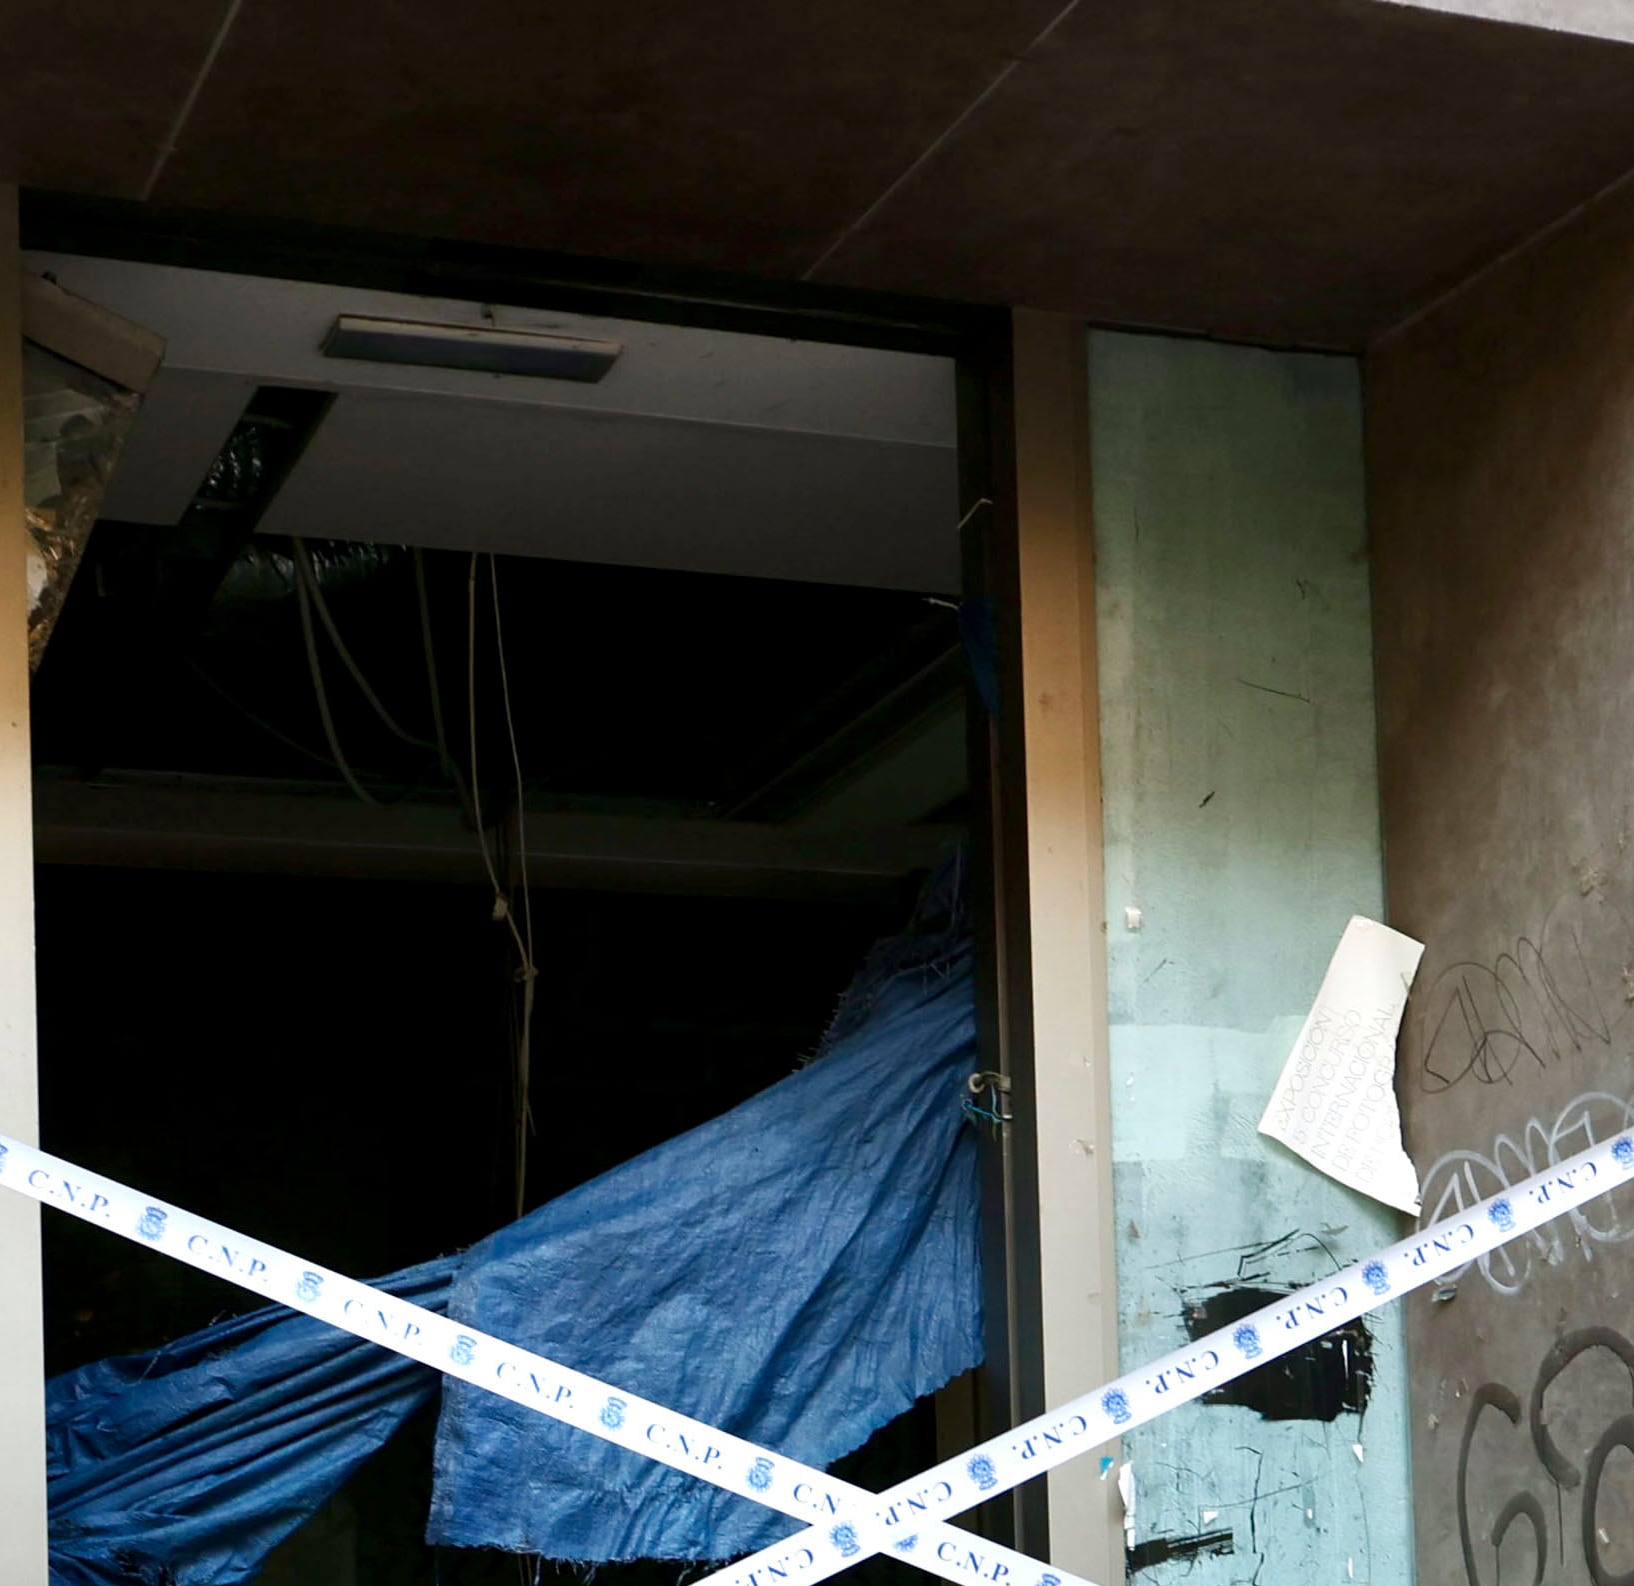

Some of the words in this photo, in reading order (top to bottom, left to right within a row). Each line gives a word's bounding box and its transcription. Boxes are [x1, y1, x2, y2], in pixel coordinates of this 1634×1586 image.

[1529, 1158, 1597, 1204] C.N.P.
[1398, 1215, 1474, 1267] C.N.P.
[1271, 1280, 1348, 1329] C.N.P.
[27, 1169, 110, 1217] C.N.P.
[187, 1234, 267, 1276] C.N.P.
[343, 1299, 421, 1340] C.N.P.
[495, 1362, 573, 1408] C.N.P.
[645, 1423, 722, 1469] C.N.P.
[936, 1541, 1010, 1586] C.N.P.
[1145, 1340, 1220, 1394] C.N.P.
[1011, 1415, 1088, 1460] C.N.P.
[875, 1480, 953, 1526] C.N.P.
